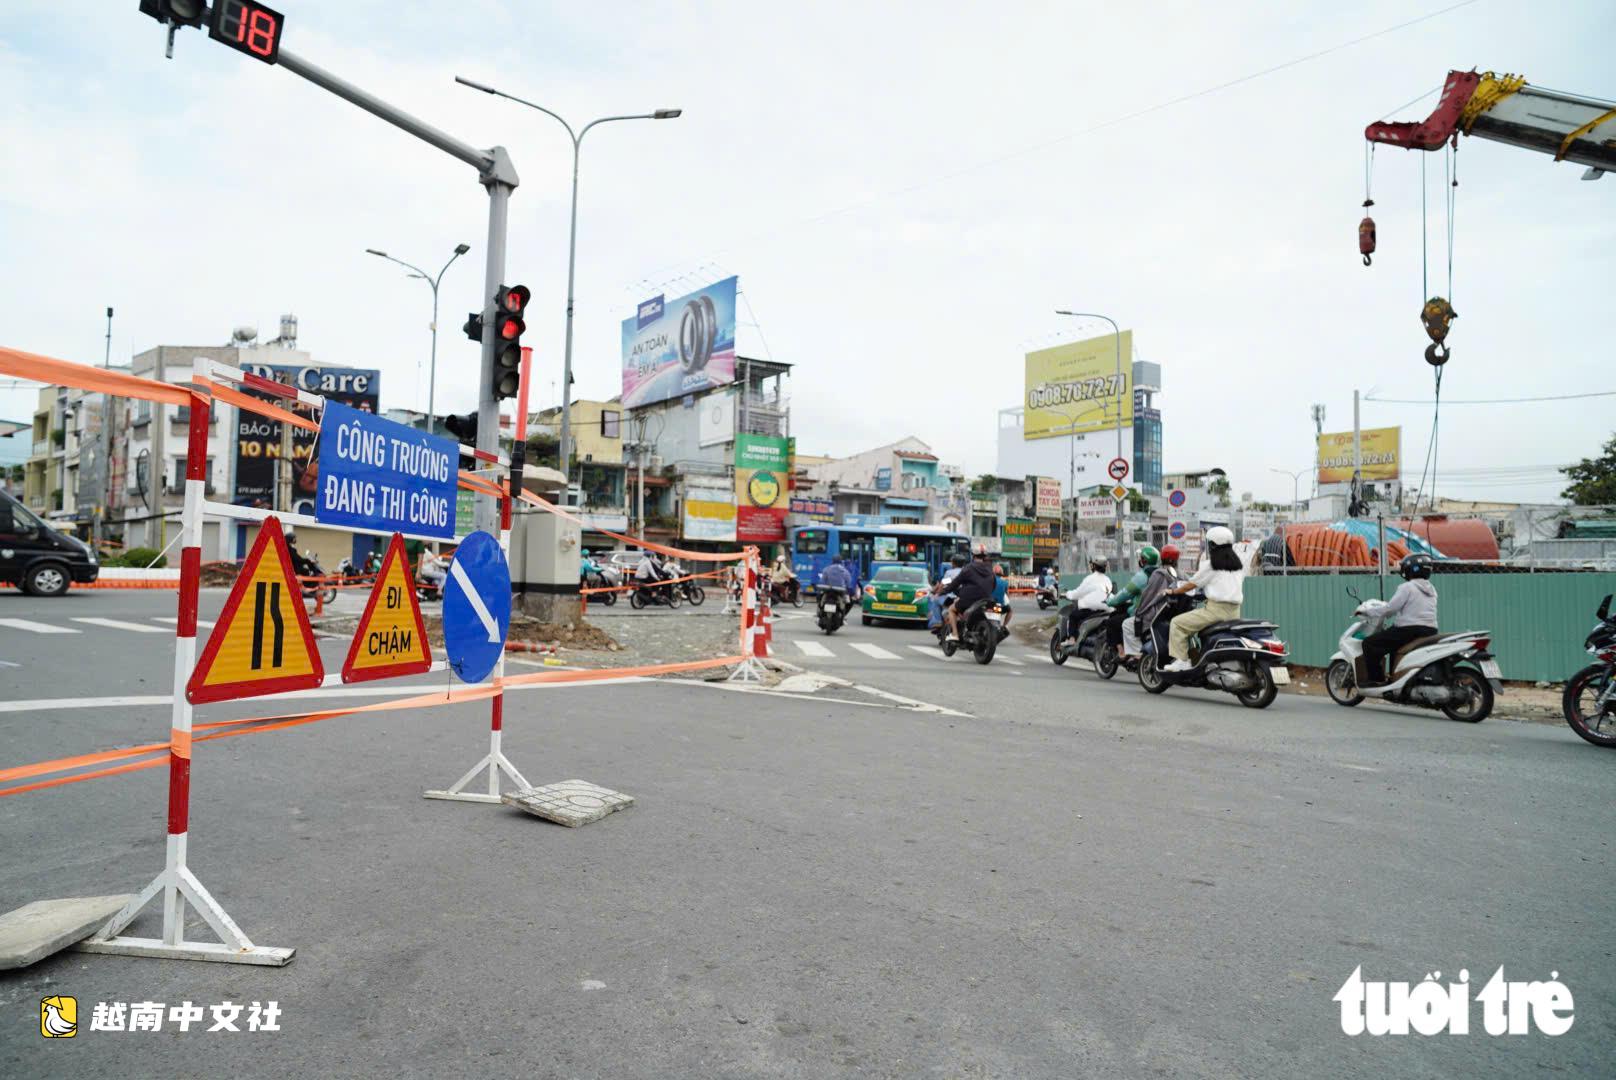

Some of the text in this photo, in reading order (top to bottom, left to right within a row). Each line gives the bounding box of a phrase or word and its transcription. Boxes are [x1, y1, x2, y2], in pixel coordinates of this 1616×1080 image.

[237, 7, 275, 56] 18
[298, 367, 369, 393] Care
[1029, 373, 1127, 410] 0908.70.72.71
[239, 420, 271, 437] BẢO
[239, 441, 314, 459] 10 NM
[337, 420, 449, 483] CÔNG TRƯỜNG
[325, 474, 376, 517] ĐANG
[381, 486, 406, 521] THI
[410, 488, 448, 528] CÔNG
[387, 586, 402, 609] ĐI
[368, 625, 411, 659] CHẬM
